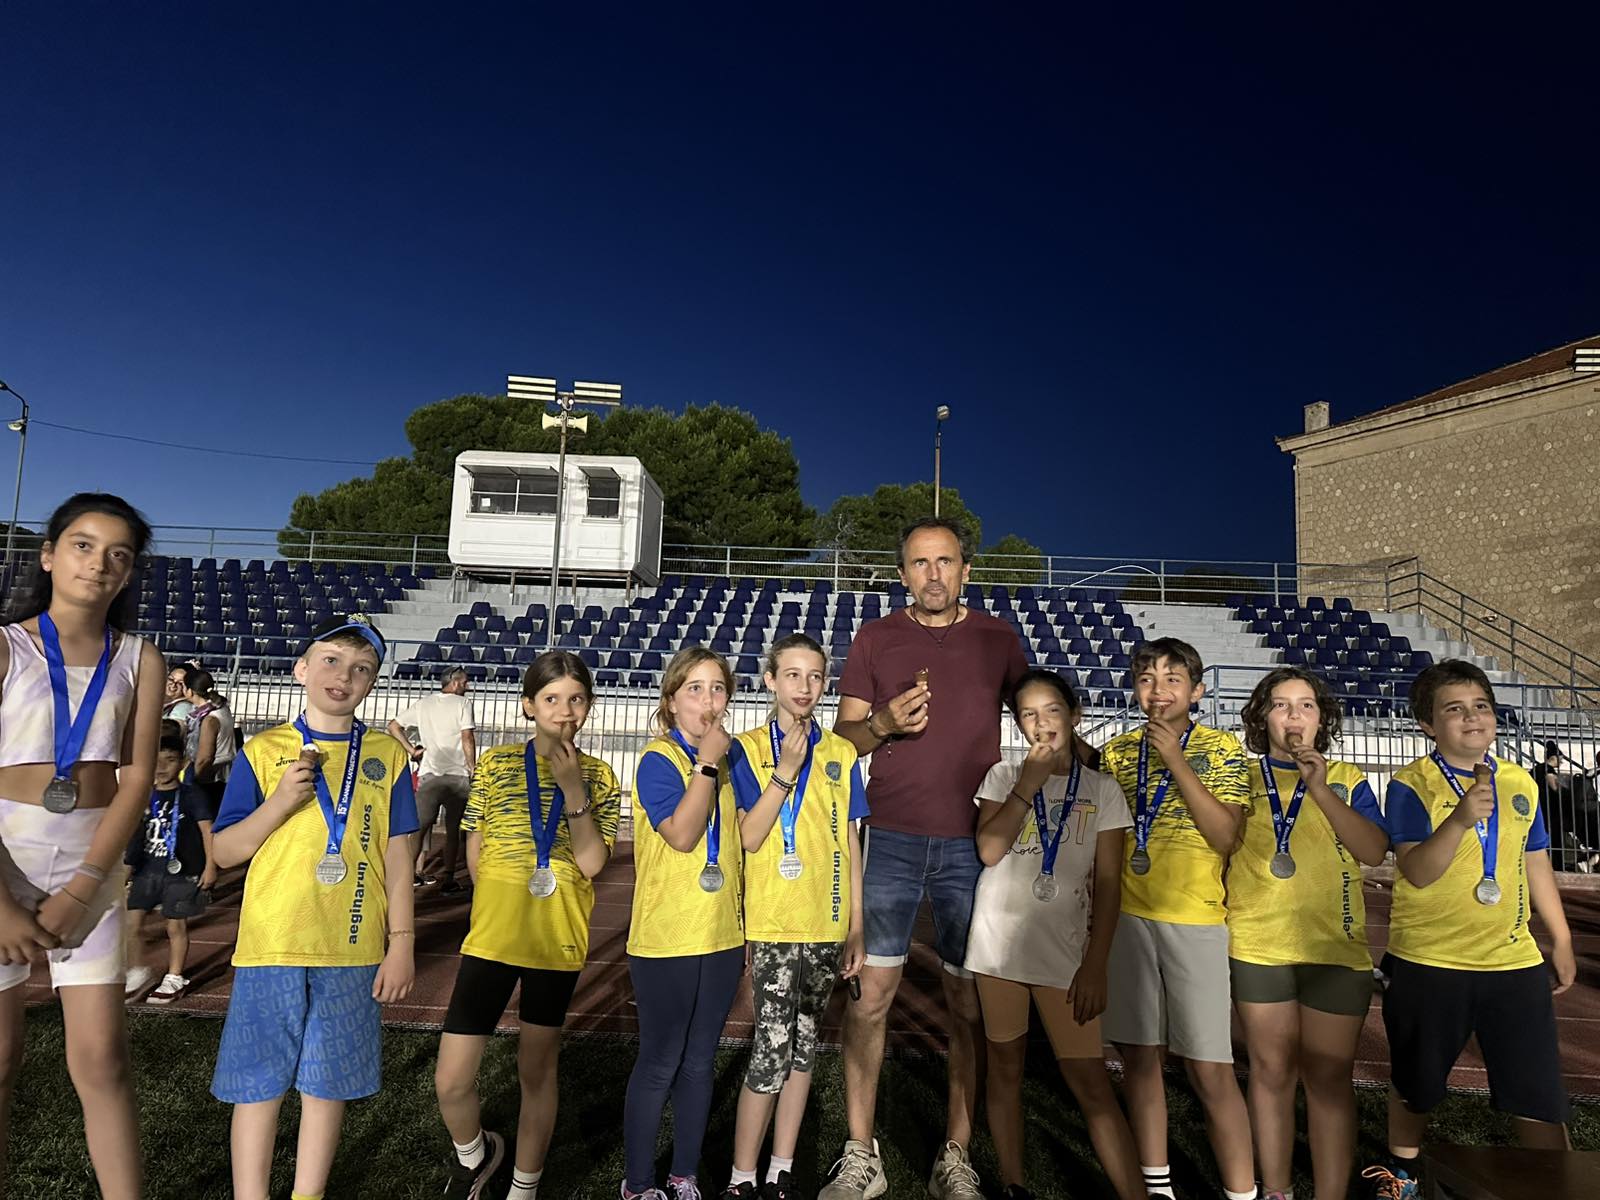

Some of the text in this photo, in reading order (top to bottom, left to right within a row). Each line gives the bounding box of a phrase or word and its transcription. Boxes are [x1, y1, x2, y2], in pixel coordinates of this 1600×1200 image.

[348, 861, 368, 944] aeginarun
[360, 804, 373, 853] stivos
[830, 850, 842, 922] aeginarun
